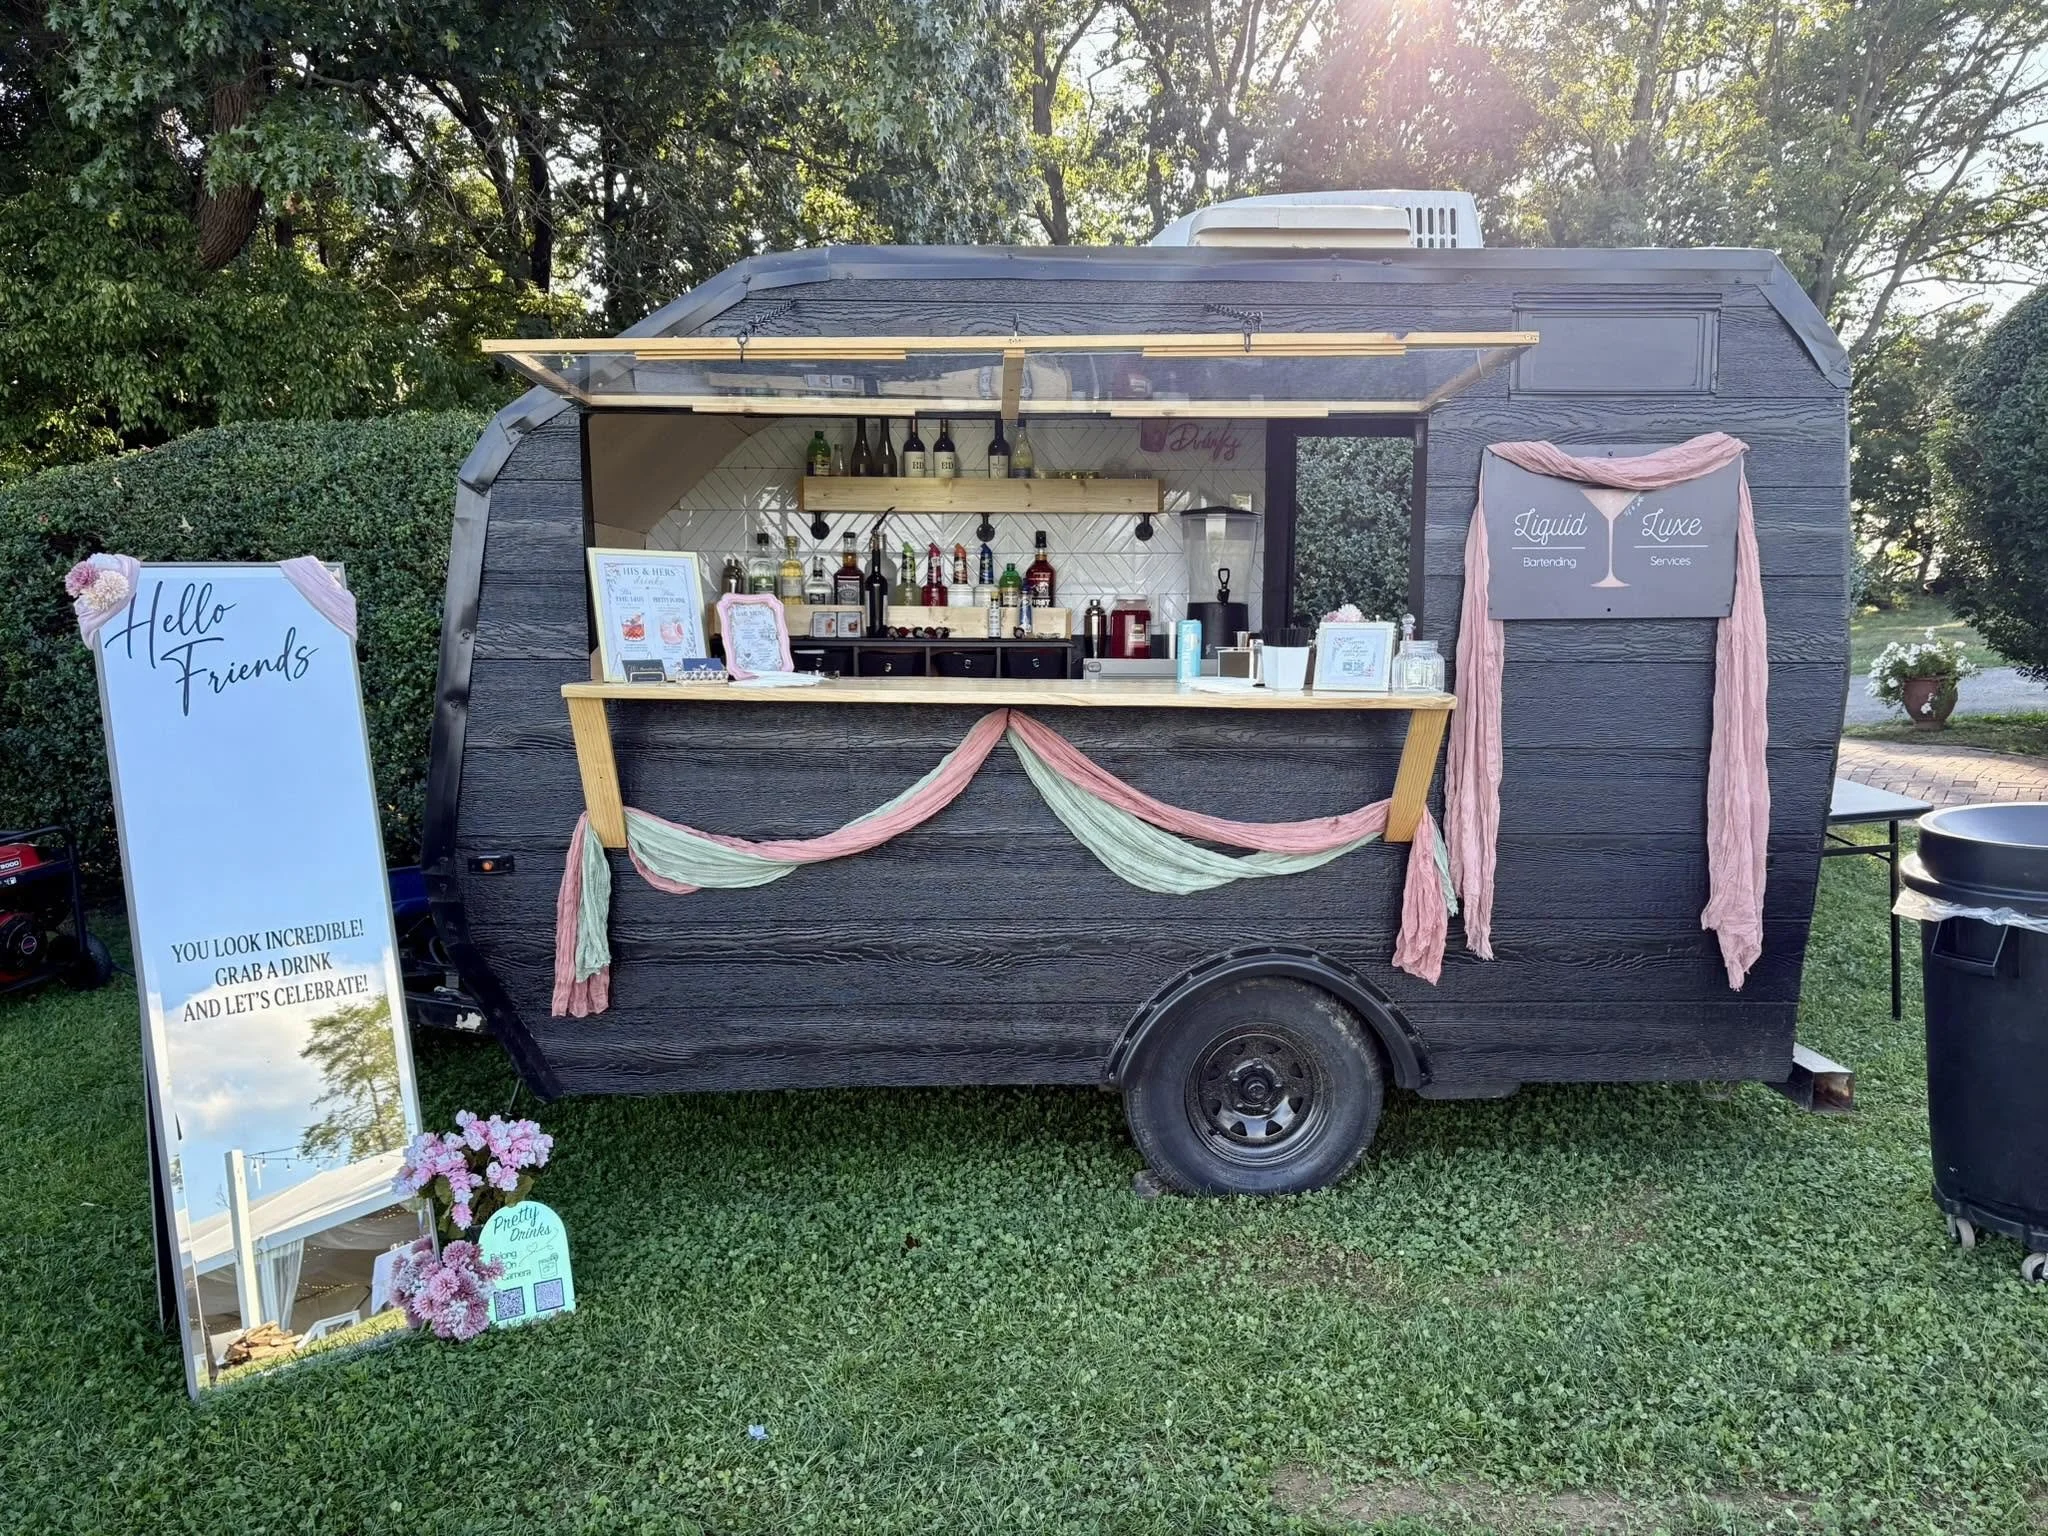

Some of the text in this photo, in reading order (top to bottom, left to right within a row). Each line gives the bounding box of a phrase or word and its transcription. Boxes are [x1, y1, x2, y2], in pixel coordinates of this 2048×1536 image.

[1514, 507, 1703, 545] Liquid Luxe
[623, 567, 676, 577] HIS & HERS
[1523, 556, 1691, 569] Bartending Services
[105, 580, 236, 669] Hello
[160, 626, 319, 716] Friends
[171, 918, 364, 963] YOU LOOK INCREDIBLE!
[215, 951, 333, 987] GRAB A DRINK
[183, 974, 369, 1022] AND LET'S CELEBRATE!
[494, 1205, 539, 1235] Pretty
[510, 1223, 551, 1241] Drinks
[505, 1261, 517, 1270] On
